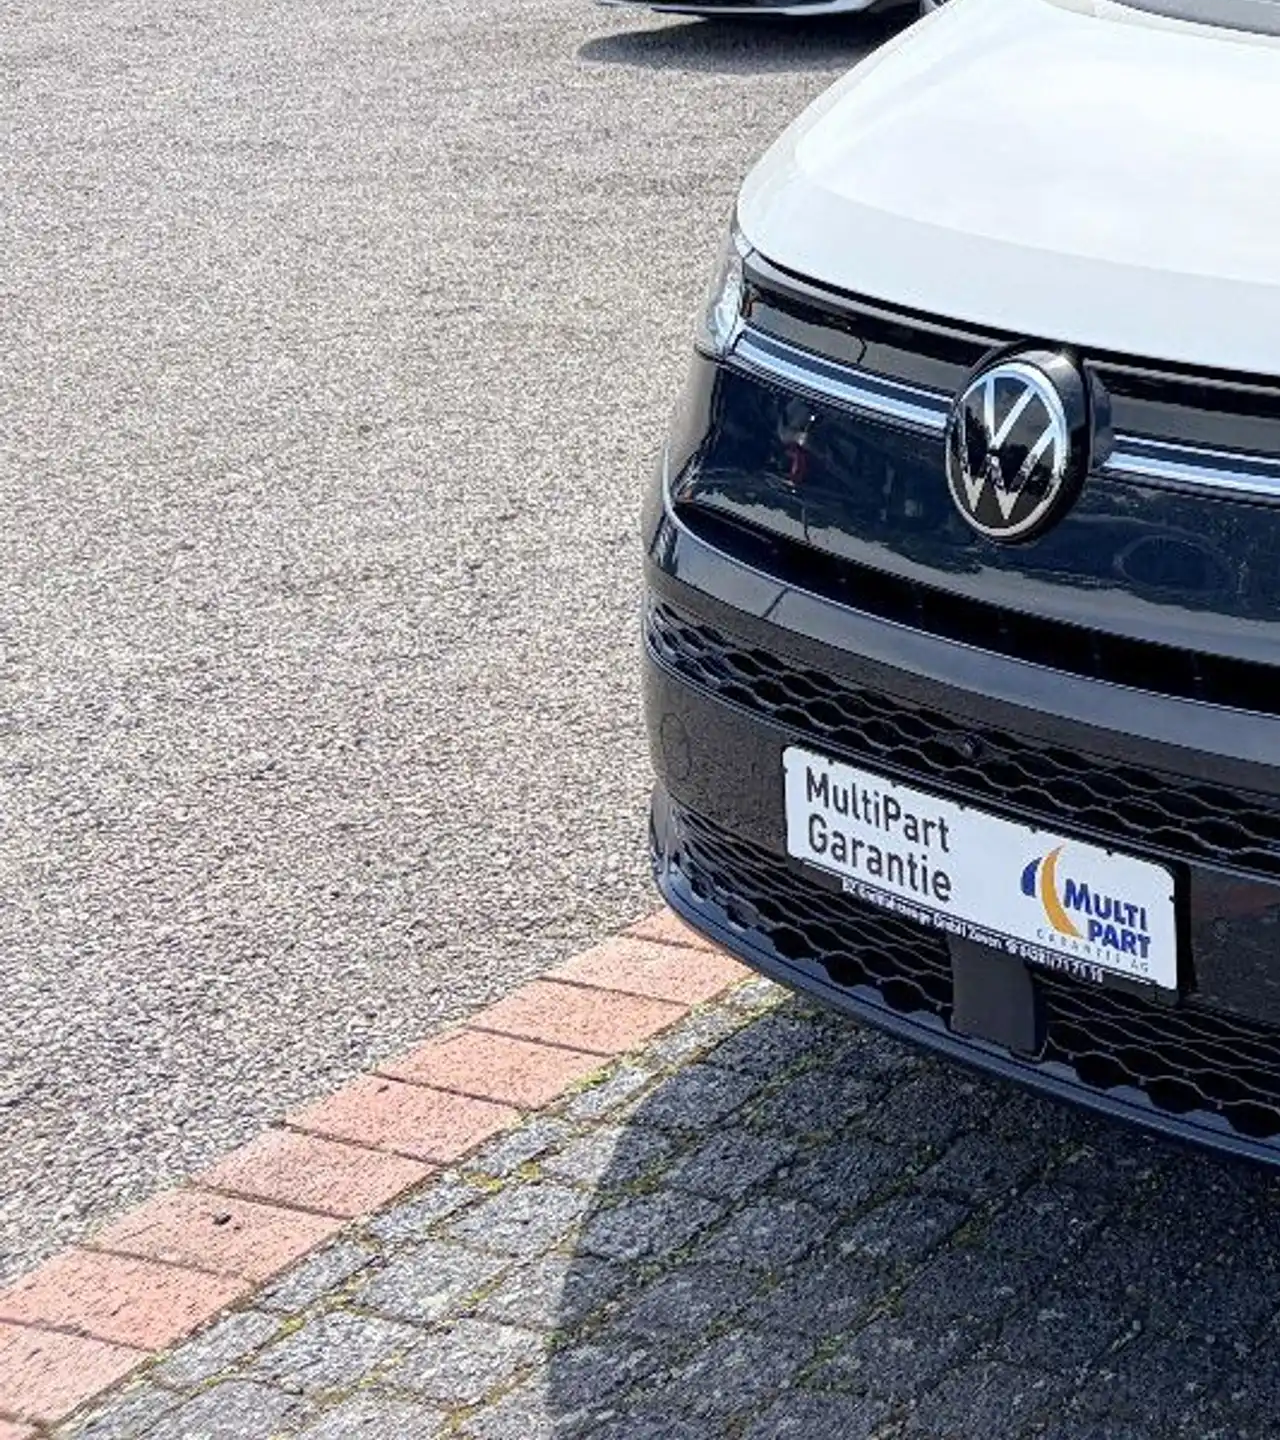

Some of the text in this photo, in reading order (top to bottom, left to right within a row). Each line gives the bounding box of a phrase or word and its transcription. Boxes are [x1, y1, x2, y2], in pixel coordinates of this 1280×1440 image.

[805, 765, 950, 853] MultiPart
[808, 812, 952, 903] Garantie
[1063, 877, 1148, 933] MULTI
[1086, 918, 1151, 959] PART
